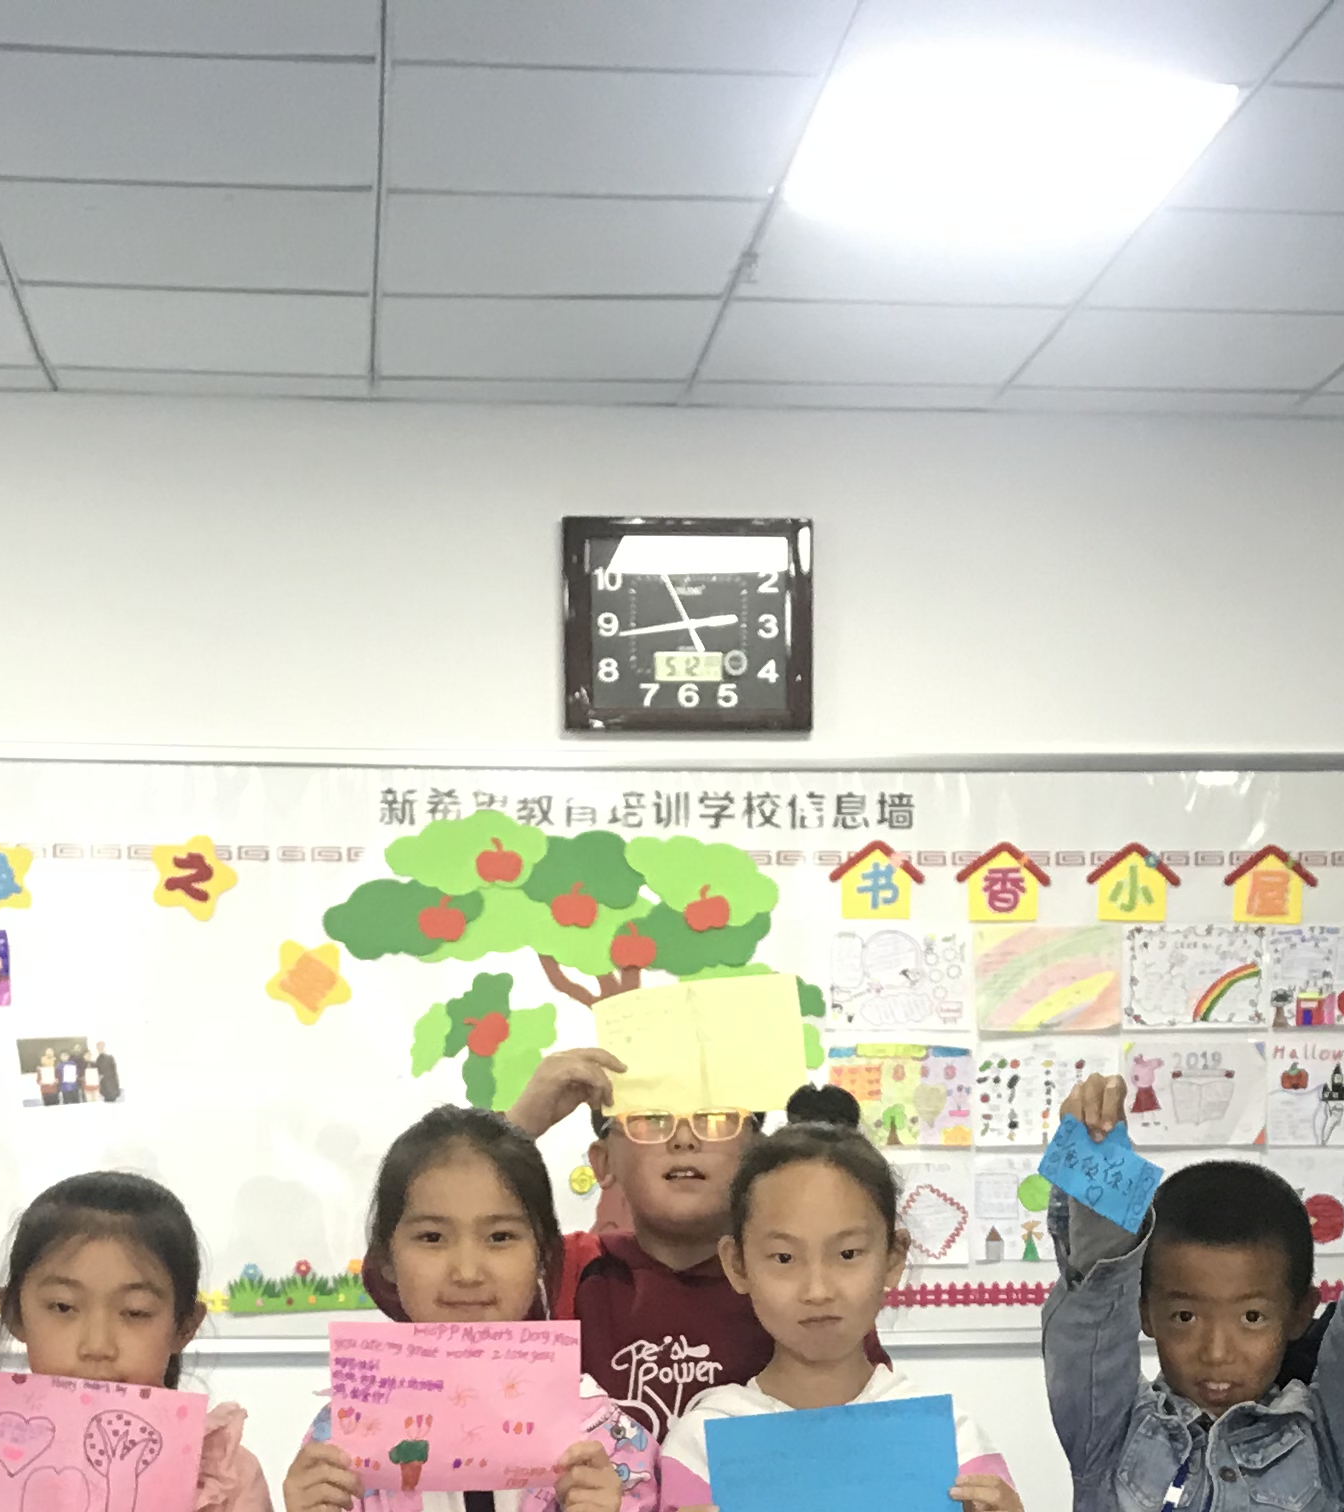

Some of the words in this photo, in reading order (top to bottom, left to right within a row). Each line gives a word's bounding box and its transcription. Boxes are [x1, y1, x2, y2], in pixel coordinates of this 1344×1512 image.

[593, 566, 623, 591] 10
[757, 571, 780, 594] 2
[597, 612, 620, 637] 9
[757, 614, 780, 639] 3
[597, 658, 620, 682] 8
[757, 659, 780, 683] 4
[639, 683, 660, 708] 7
[677, 683, 700, 708] 6
[717, 683, 739, 708] 5
